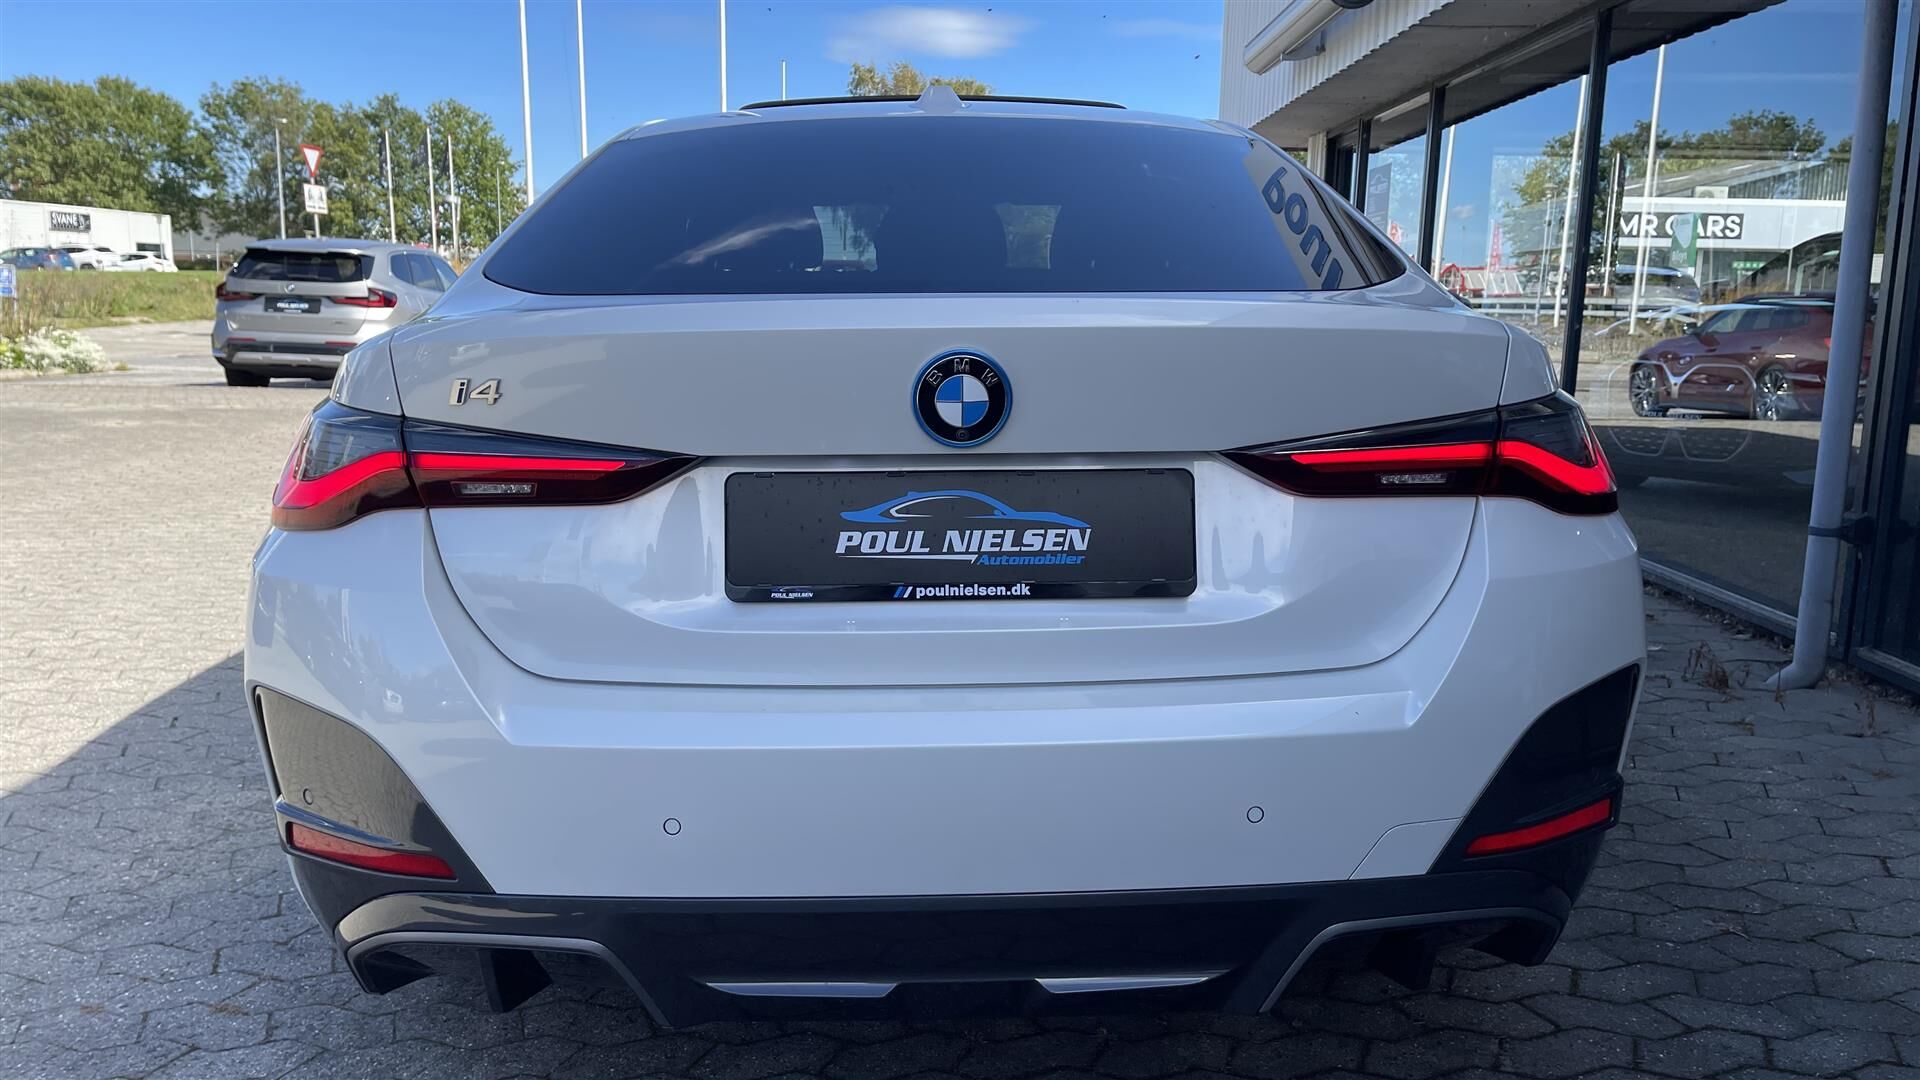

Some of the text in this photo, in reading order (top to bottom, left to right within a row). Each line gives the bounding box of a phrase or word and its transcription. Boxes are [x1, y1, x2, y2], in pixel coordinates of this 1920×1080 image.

[51, 211, 79, 226] SVANE
[1620, 214, 1658, 236] MR
[926, 358, 998, 387] BMW
[449, 379, 502, 405] i4
[835, 528, 1092, 553] POUL NIELSEN
[977, 554, 1086, 566] Automobiler
[916, 583, 1031, 599] poulnielsen.dk
